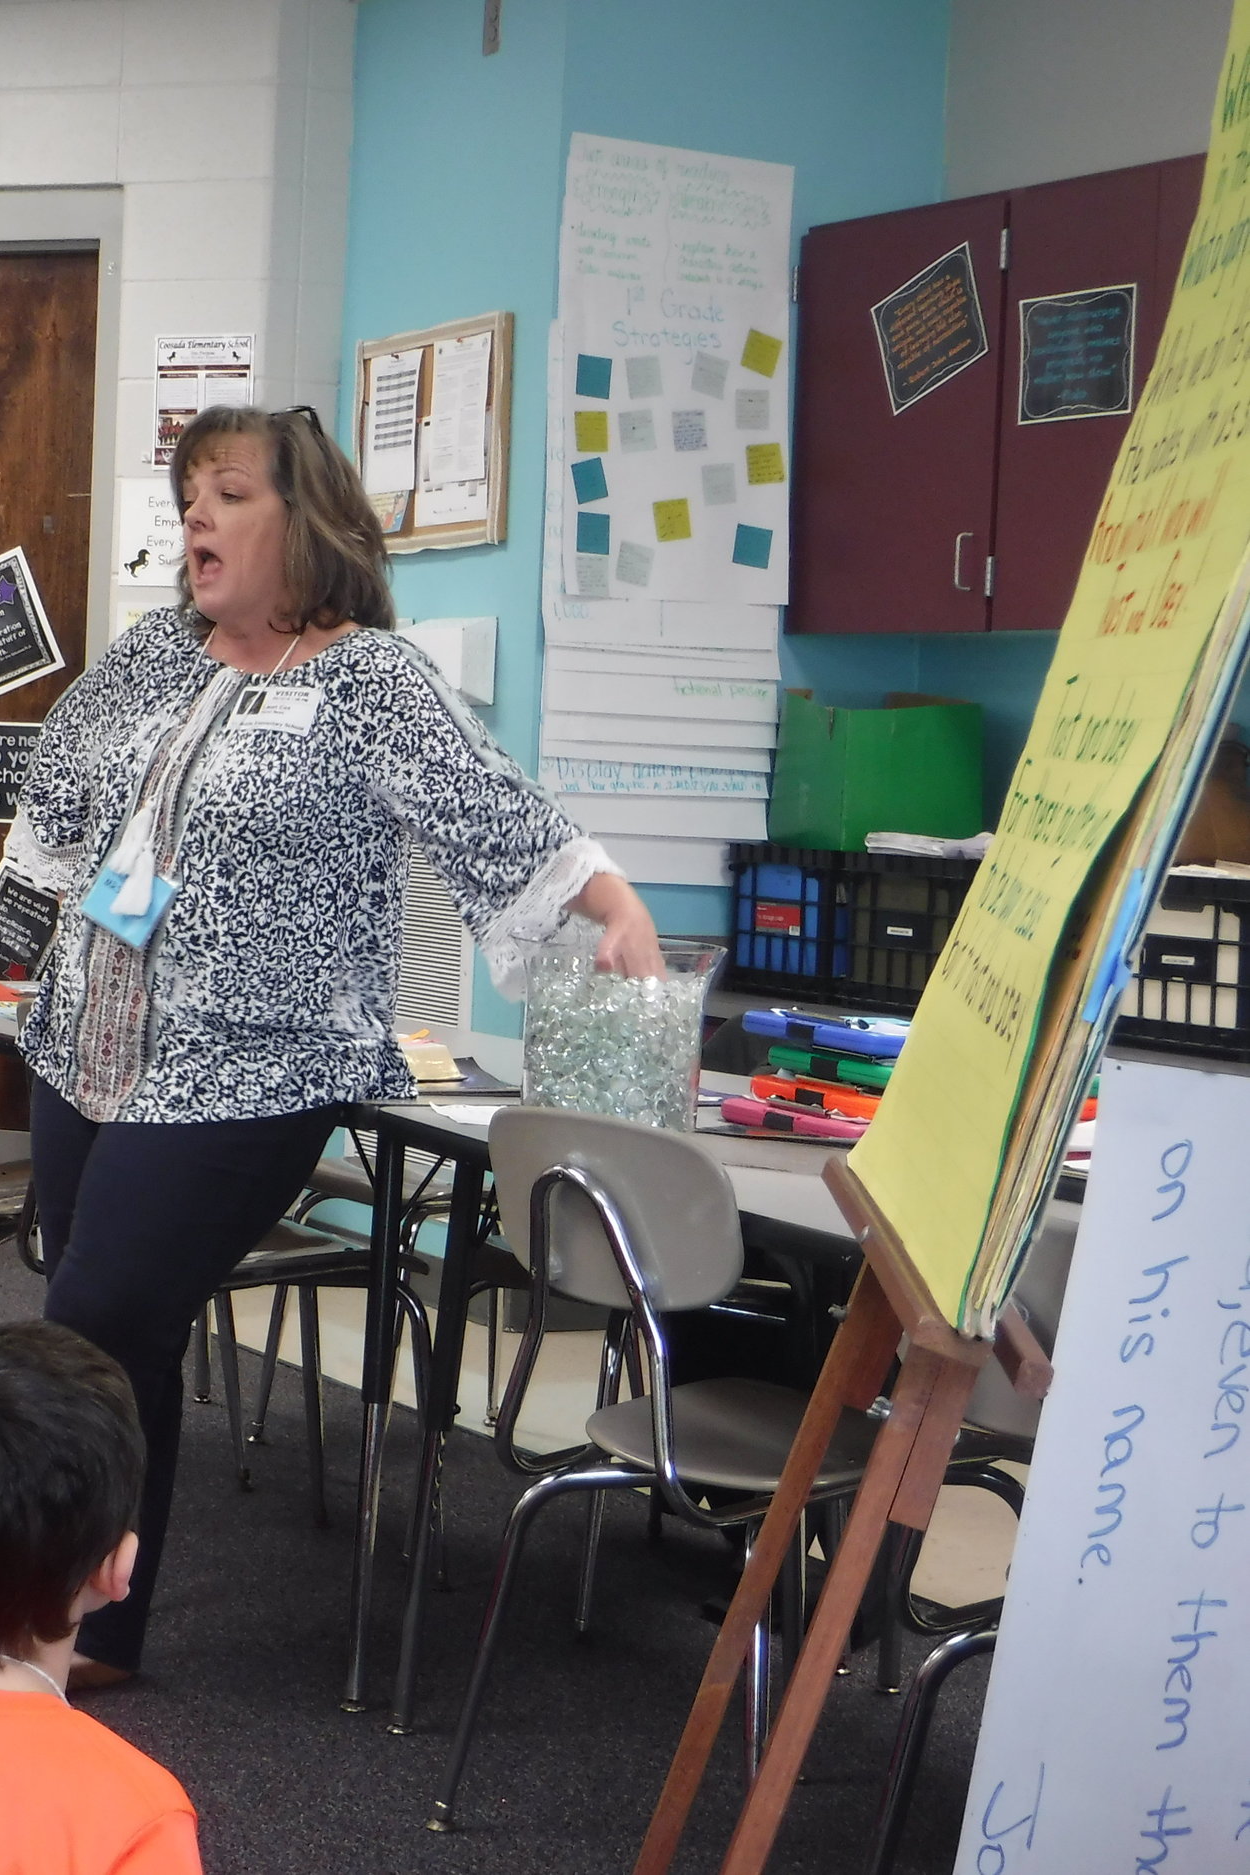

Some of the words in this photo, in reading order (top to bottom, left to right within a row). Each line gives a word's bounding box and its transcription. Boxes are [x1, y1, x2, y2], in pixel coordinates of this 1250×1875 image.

[660, 288, 726, 323] Grade
[188, 340, 227, 351] Elementary
[228, 339, 249, 348] School
[612, 320, 722, 365] Strategies
[146, 535, 175, 547] Every
[0, 632, 17, 647] stuff
[18, 628, 26, 637] of
[274, 690, 309, 698] VISITOR
[18, 735, 38, 747] ne
[7, 751, 30, 768] yo
[3, 896, 13, 905] we
[13, 902, 52, 927] repeatedly
[8, 887, 18, 898] We
[19, 894, 32, 904] are
[33, 902, 50, 913] what
[16, 935, 30, 944] not
[30, 942, 40, 951] an
[1152, 1139, 1192, 1221] on
[1121, 1255, 1189, 1363] his
[1075, 1402, 1146, 1586] name.
[1190, 1494, 1246, 1550] to
[1156, 1588, 1227, 1751] them
